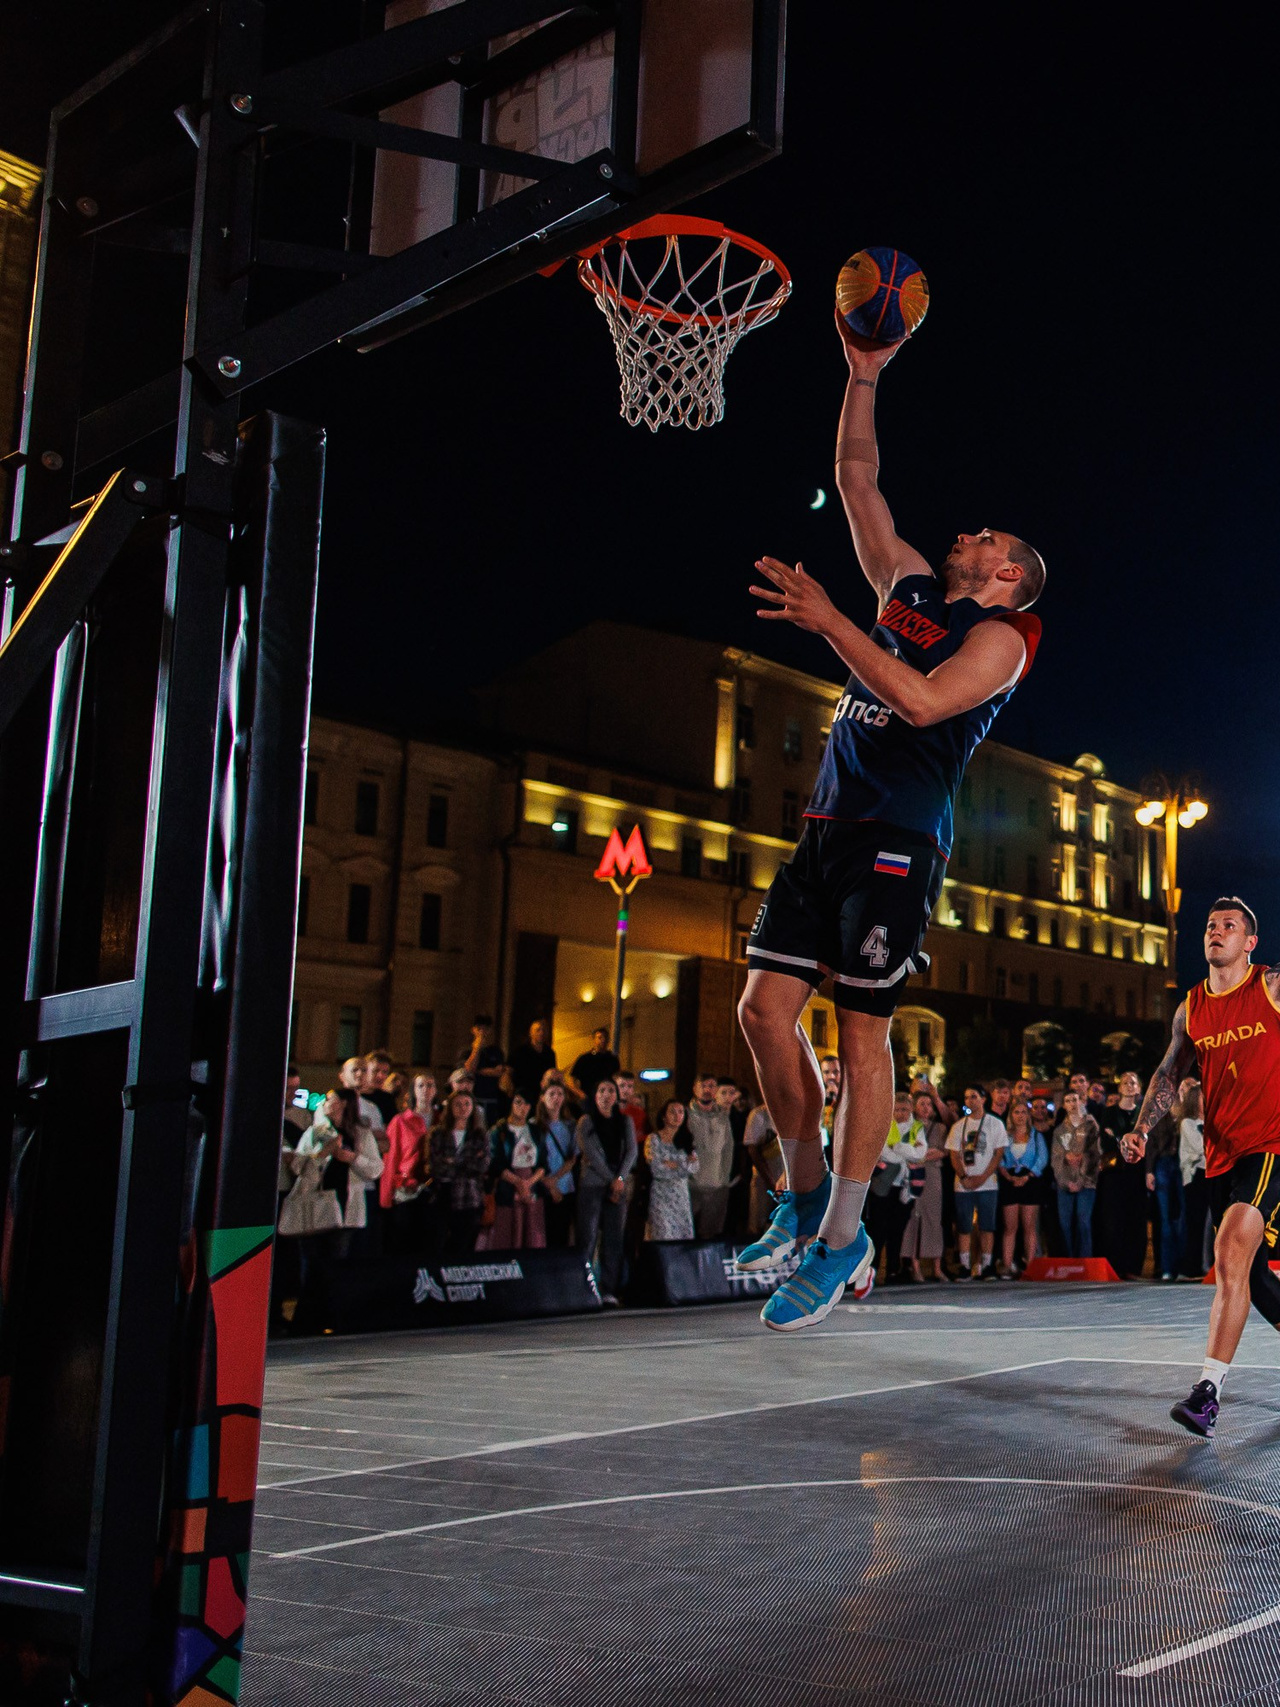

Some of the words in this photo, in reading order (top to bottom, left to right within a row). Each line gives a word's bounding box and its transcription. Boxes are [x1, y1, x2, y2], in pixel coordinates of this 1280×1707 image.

[878, 598, 949, 650] RUSSIA
[860, 925, 890, 968] 4
[1228, 1062, 1238, 1079] 1
